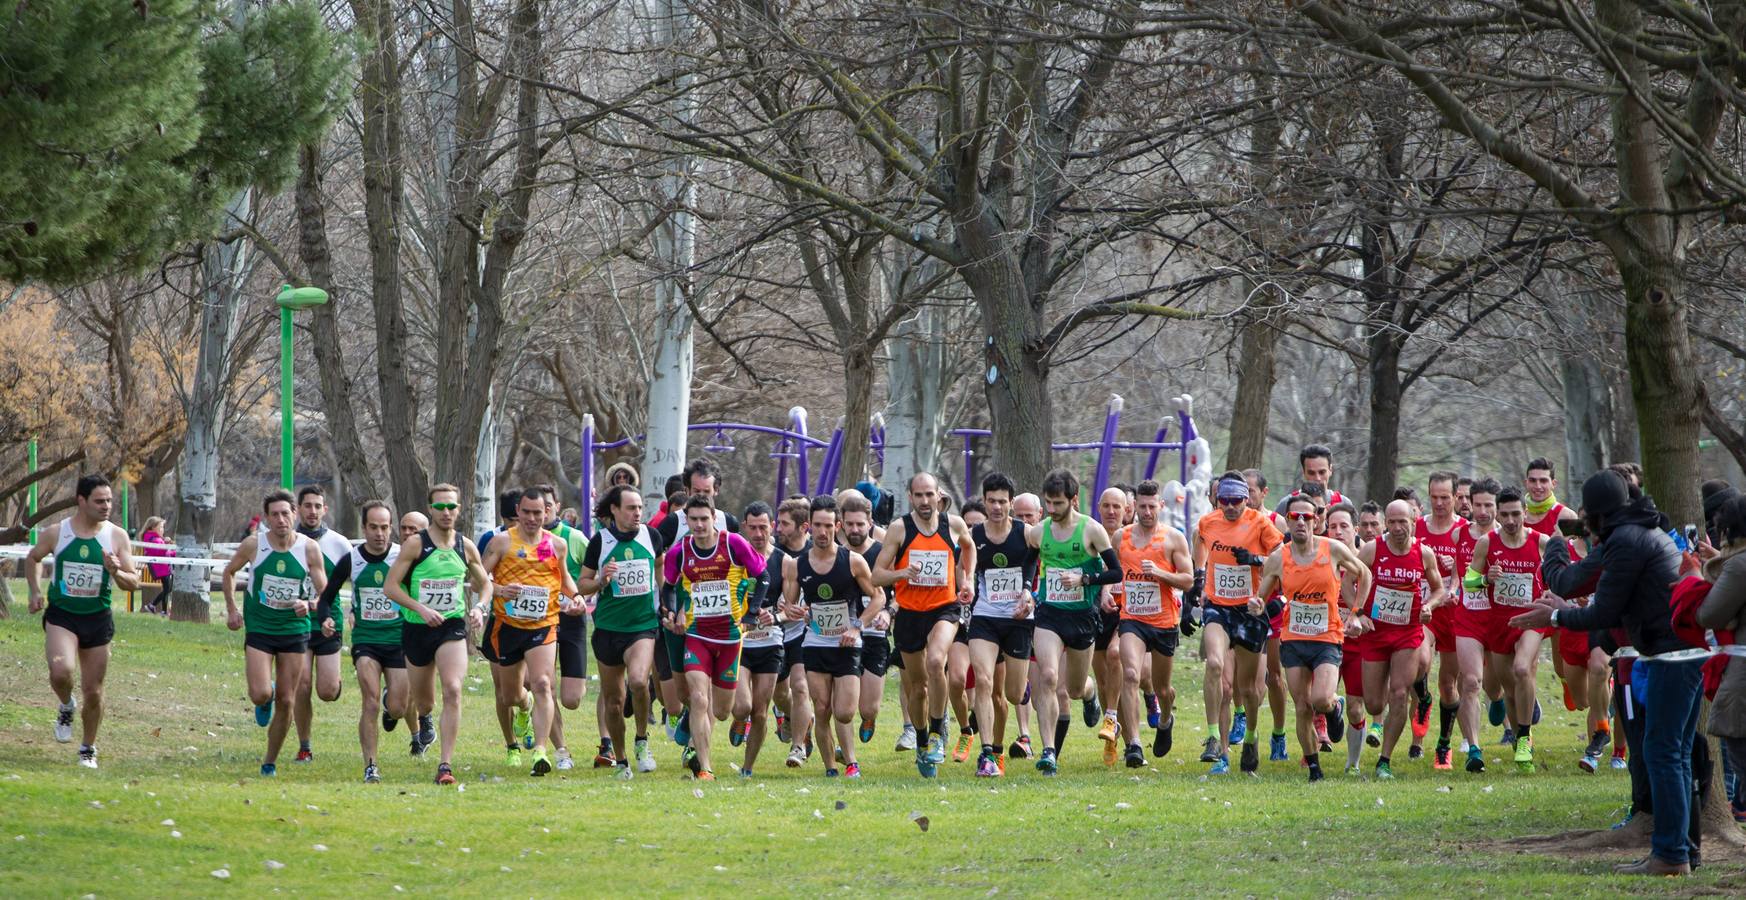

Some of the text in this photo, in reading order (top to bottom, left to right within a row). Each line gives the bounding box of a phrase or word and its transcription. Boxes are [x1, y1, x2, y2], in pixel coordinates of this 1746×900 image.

[67, 572, 94, 588] 561
[617, 570, 644, 586] 568
[1219, 575, 1245, 588] 855
[1377, 566, 1421, 582] La Rioja
[992, 578, 1016, 592] 871
[1048, 578, 1077, 591] 10
[1499, 581, 1526, 597] 206
[266, 585, 294, 601] 553
[426, 593, 452, 604] 773
[1130, 591, 1154, 605] 857
[512, 597, 546, 612] 1459
[693, 594, 728, 608] 1475
[1379, 597, 1407, 614] 344
[818, 613, 843, 628] 872
[1295, 611, 1322, 626] 850
